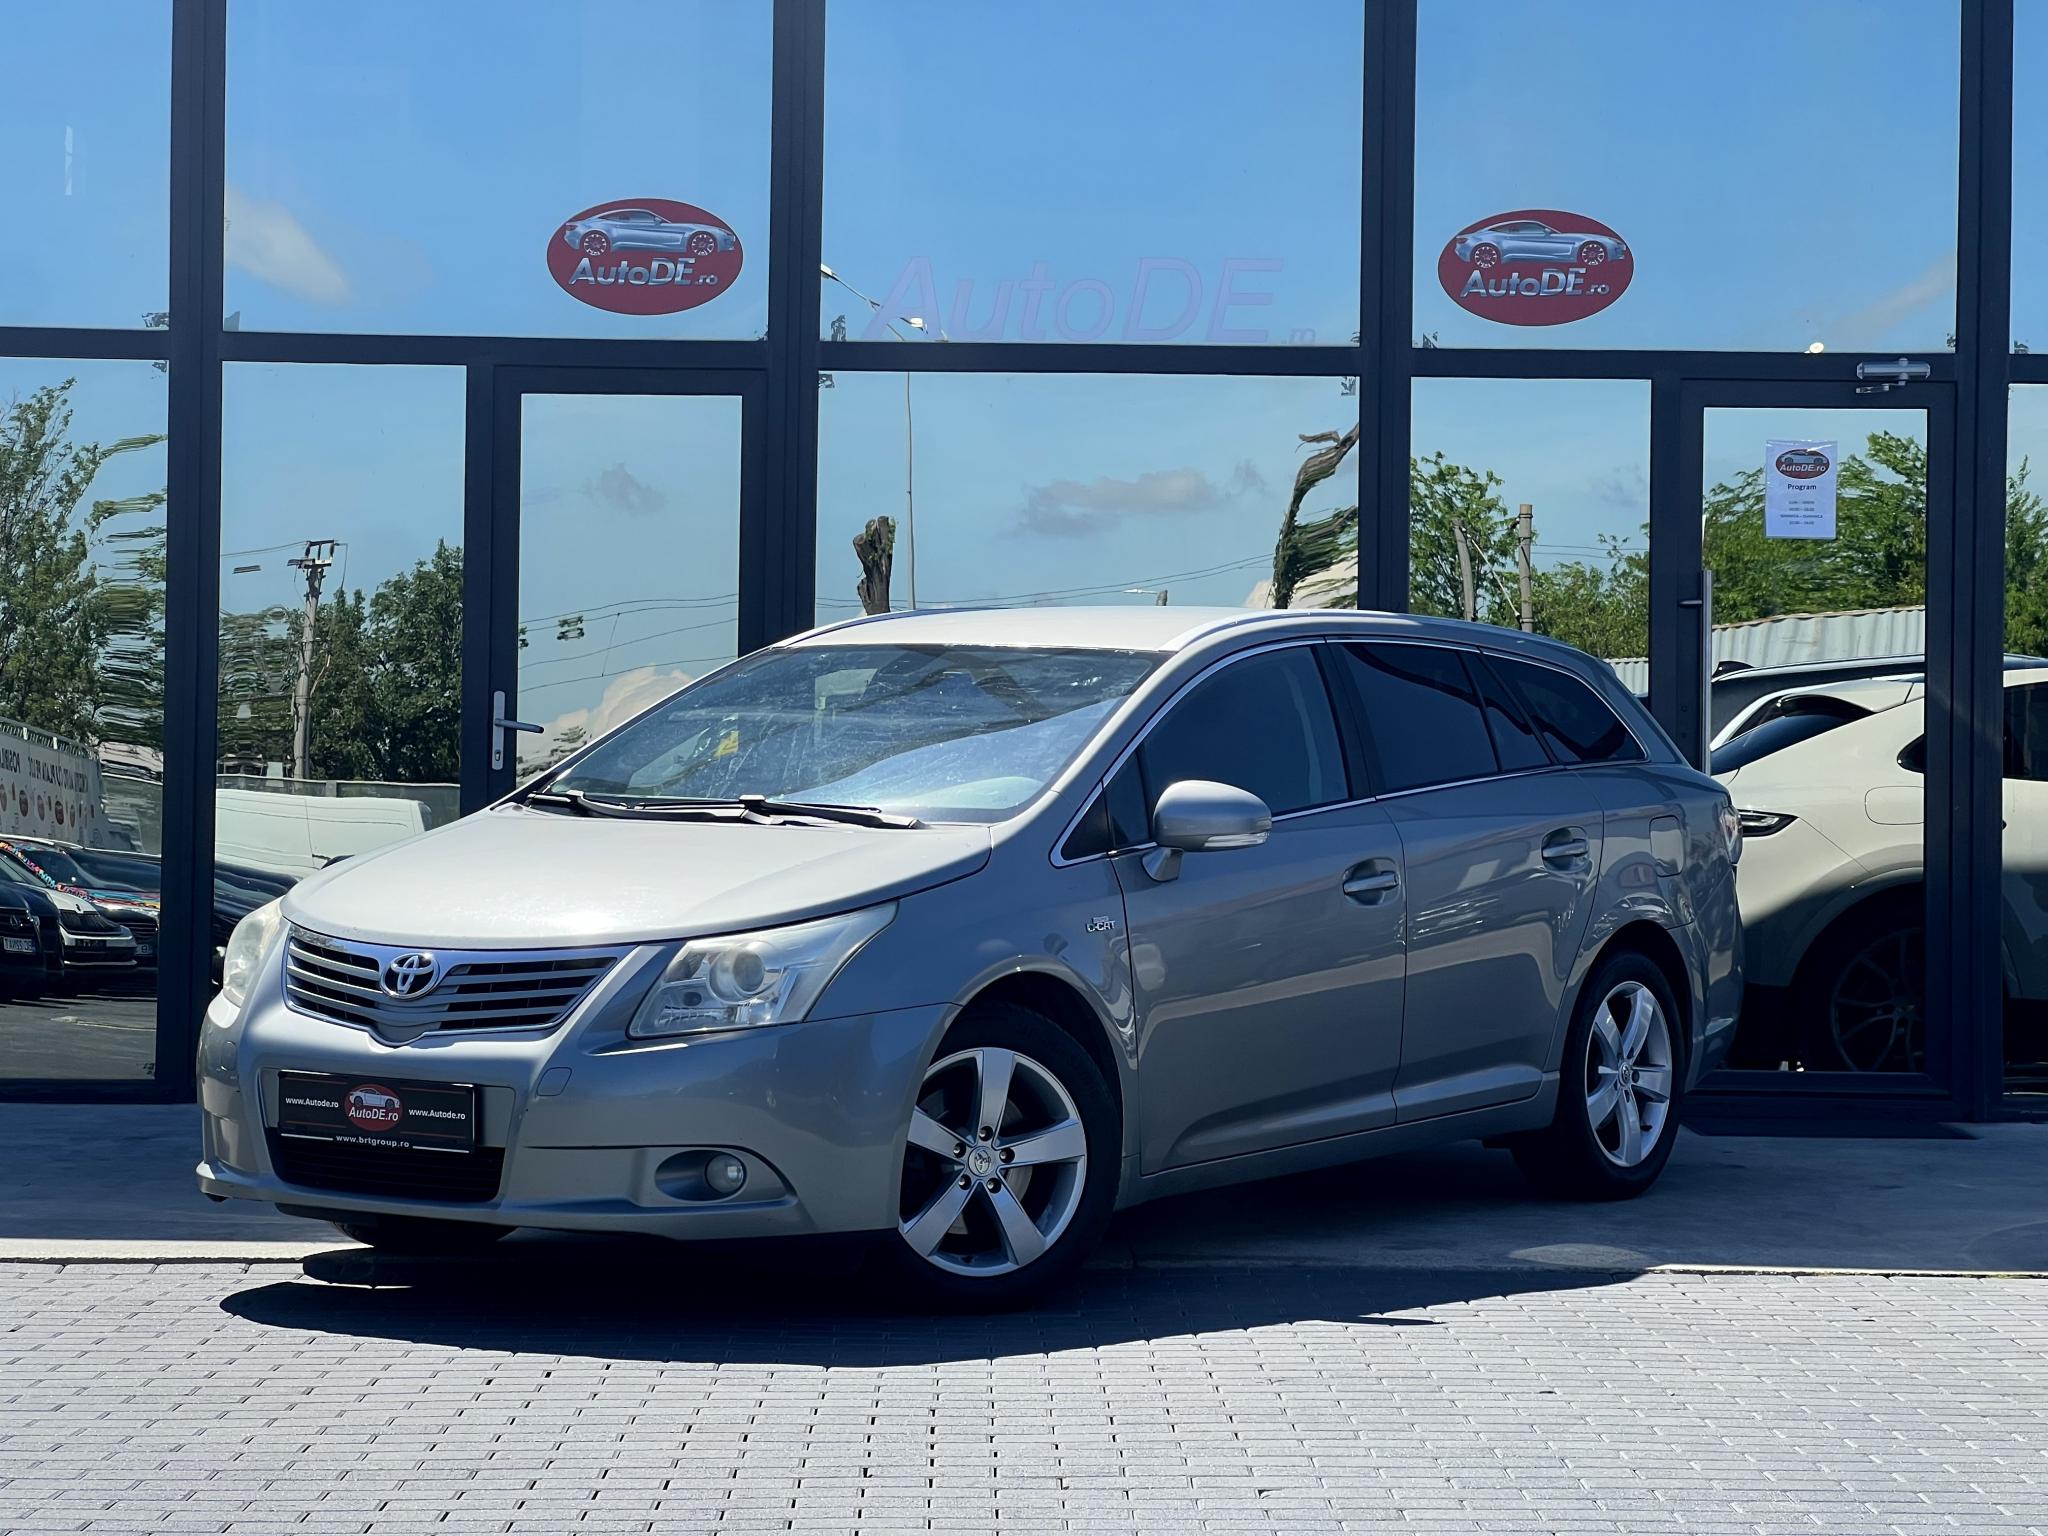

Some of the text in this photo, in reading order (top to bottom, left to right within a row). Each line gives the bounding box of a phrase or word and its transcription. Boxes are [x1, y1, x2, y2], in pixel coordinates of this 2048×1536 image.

[285, 1096, 339, 1109] www.Autode.ro
[348, 1106, 399, 1122] AutoDE.ro
[408, 1107, 466, 1120] www.Autode.ro
[336, 1134, 410, 1148] www.brtgroup.ro
